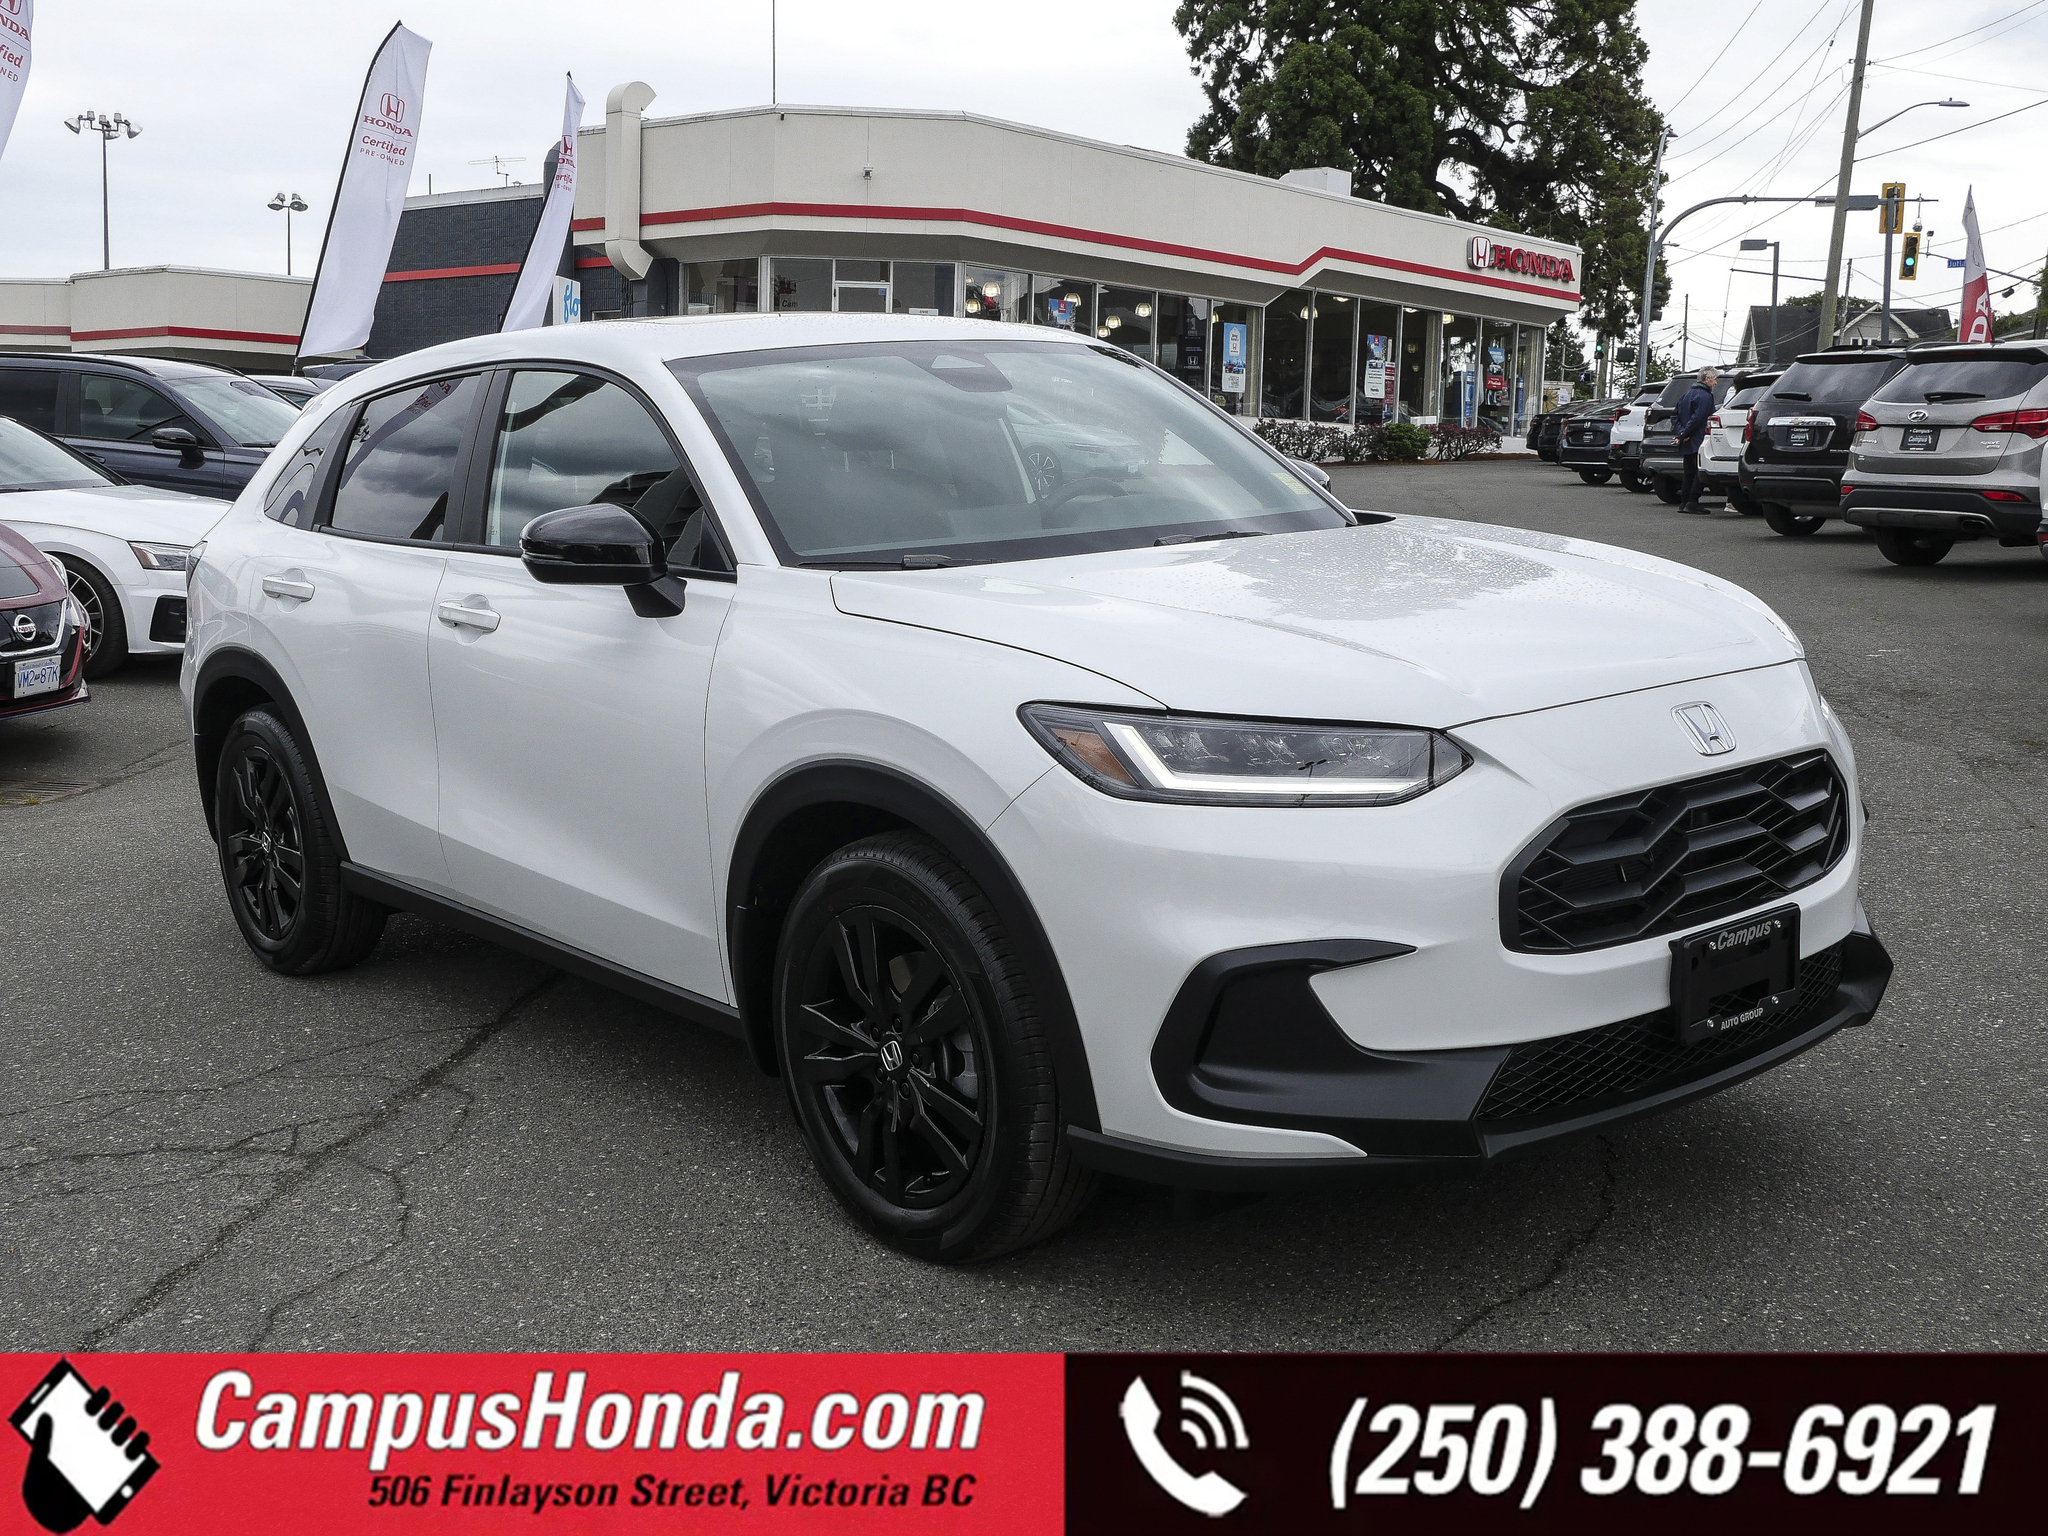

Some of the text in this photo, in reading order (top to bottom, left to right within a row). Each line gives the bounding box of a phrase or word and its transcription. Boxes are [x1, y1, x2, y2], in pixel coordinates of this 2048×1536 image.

[363, 115, 413, 137] HONDA
[360, 148, 405, 166] PRE-OWNED
[362, 135, 407, 156] Certifed
[1493, 244, 1575, 281] HONDA
[564, 280, 580, 323] flo
[17, 670, 36, 688] VM2
[40, 665, 59, 684] 87K
[1717, 921, 1772, 950] Campus
[1720, 1008, 1764, 1031] AUTO GROUP
